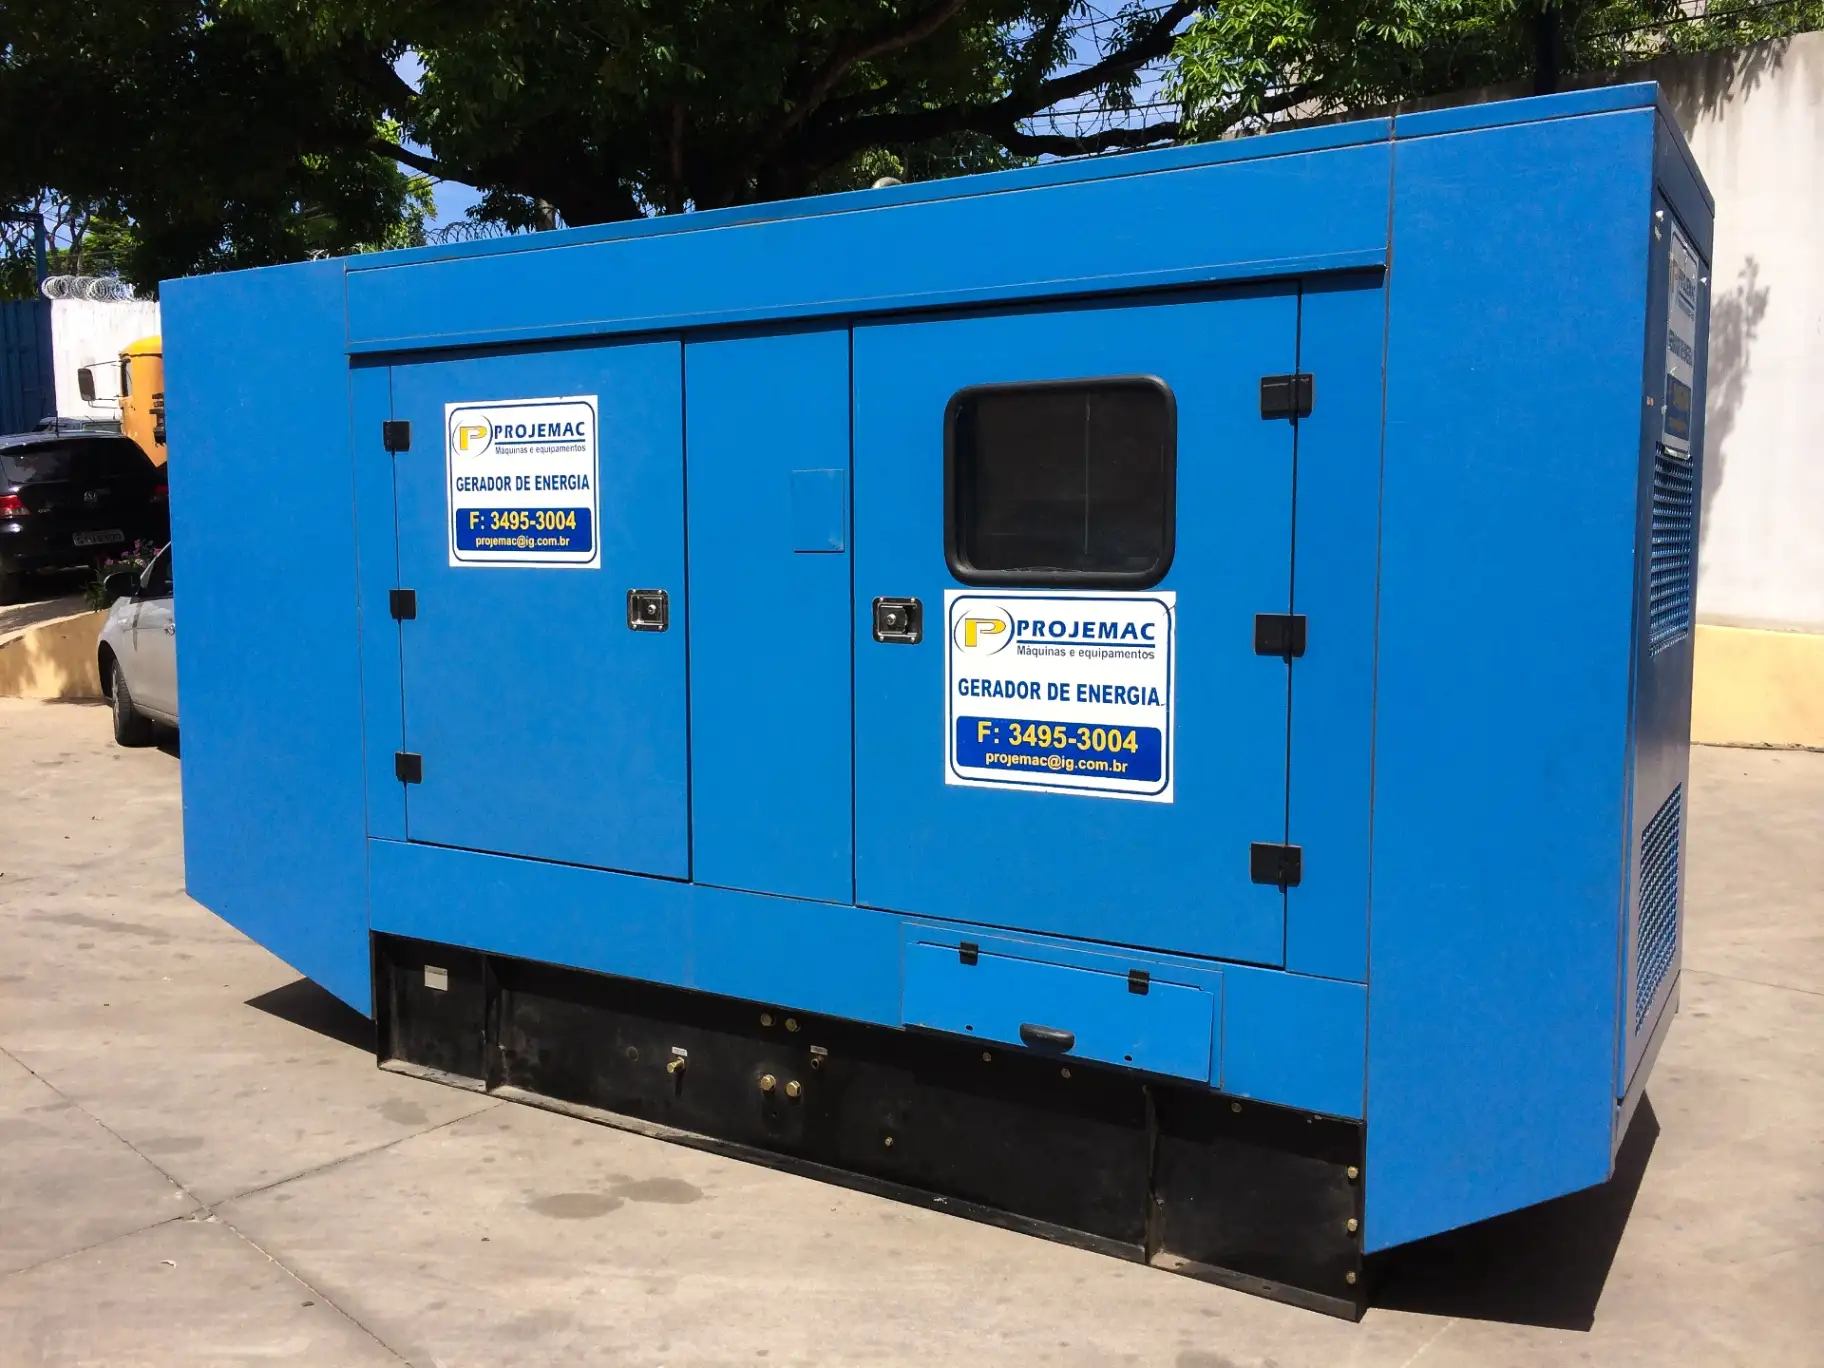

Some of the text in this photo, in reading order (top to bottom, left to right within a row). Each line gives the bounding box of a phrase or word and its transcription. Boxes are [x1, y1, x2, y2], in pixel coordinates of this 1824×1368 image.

[459, 425, 488, 451] P
[494, 421, 586, 439] PROJEMAC
[535, 444, 586, 455] equipamentos
[456, 474, 590, 492] GERADOR DE ENERGIA
[469, 510, 577, 530] F: 3495-3004
[475, 535, 570, 548] projemac@ig.com.br
[964, 617, 1007, 648] P
[1016, 619, 1156, 641] PROJEMAC
[1016, 645, 1156, 660] Máquinas e equipamentos
[958, 677, 1160, 707] GERADOR DE ENERGIA
[976, 720, 1139, 753] F: 3495-3004
[985, 751, 1128, 773] projemac@ig.com.br
